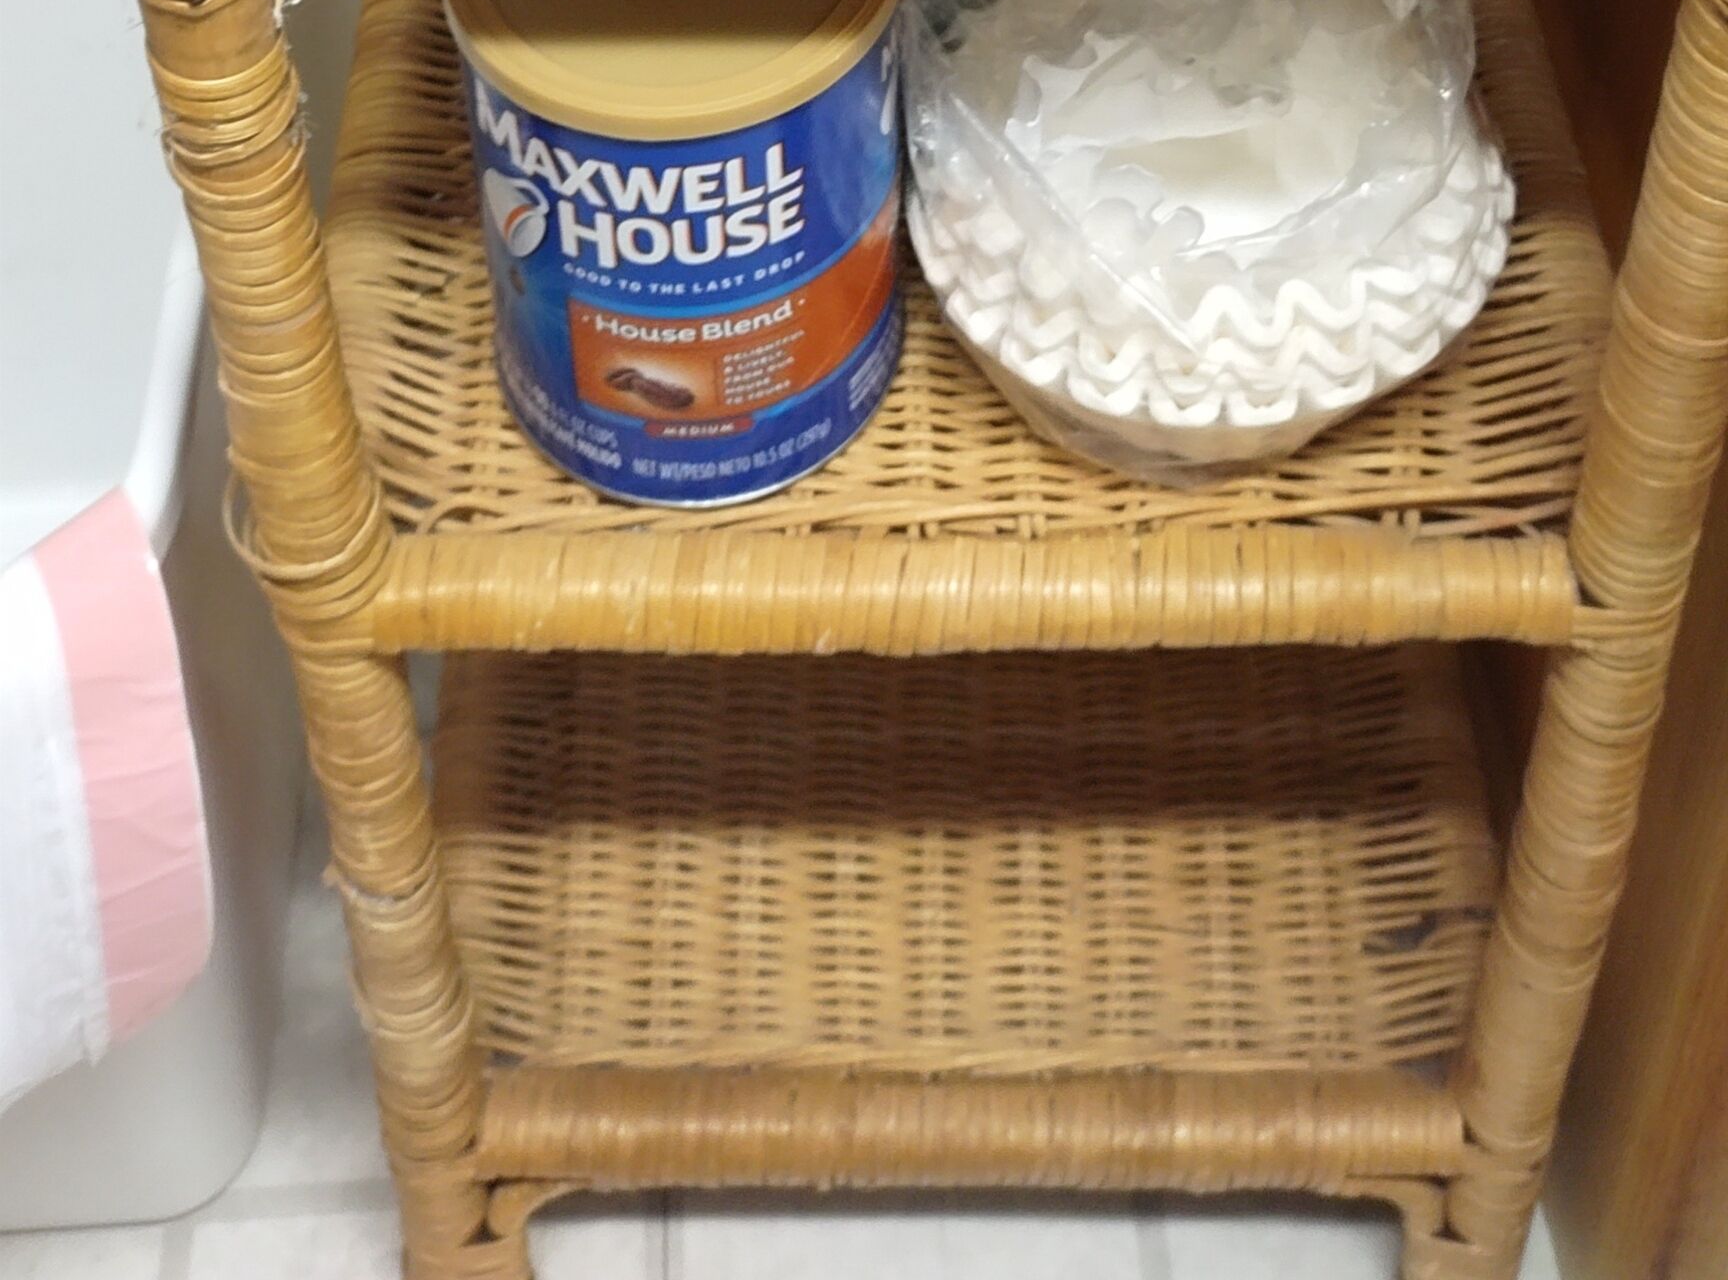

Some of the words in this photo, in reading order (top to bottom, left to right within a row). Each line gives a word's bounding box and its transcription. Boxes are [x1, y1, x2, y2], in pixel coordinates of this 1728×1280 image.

[475, 77, 805, 216] MAXWELL
[557, 184, 805, 269] HOUSE
[563, 262, 612, 287] GOOD
[618, 279, 642, 293] TO
[648, 282, 686, 295] THE
[692, 274, 745, 295] LAST
[754, 250, 806, 281] DROP
[594, 313, 697, 344] House
[701, 299, 795, 341] Blend
[662, 422, 735, 437] MEDIUM
[632, 457, 657, 477] NET
